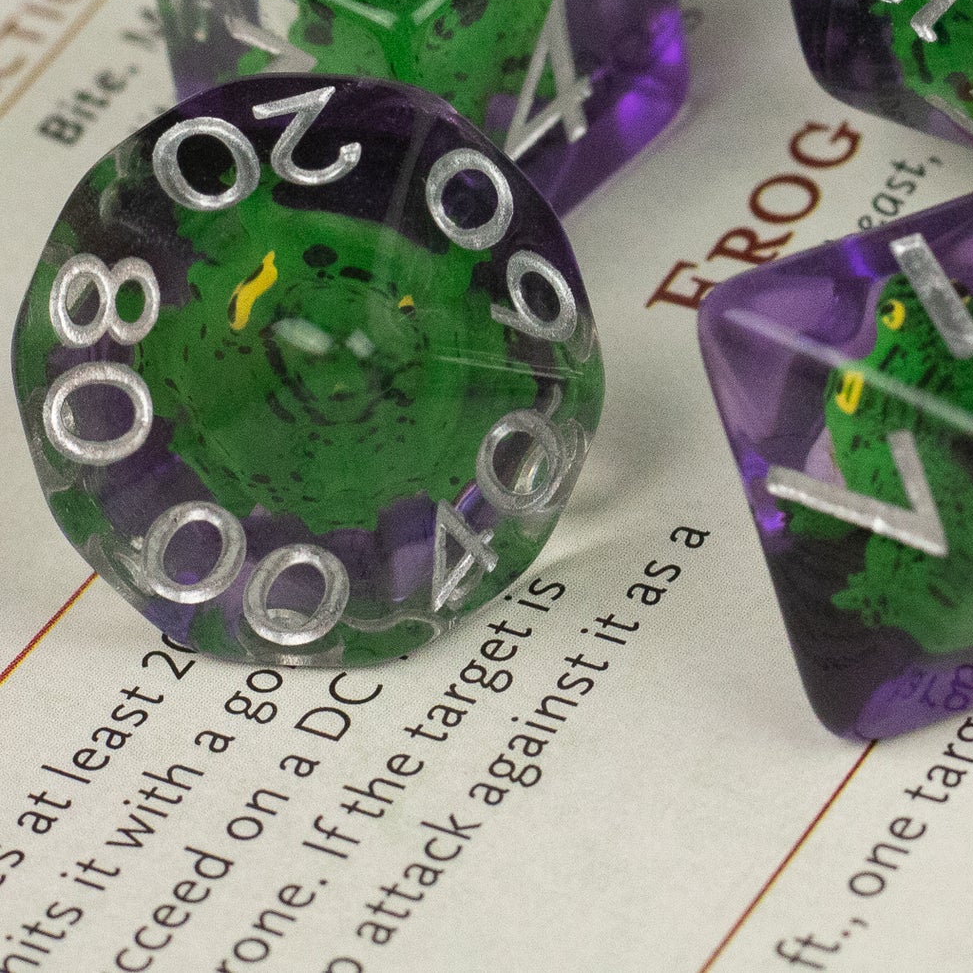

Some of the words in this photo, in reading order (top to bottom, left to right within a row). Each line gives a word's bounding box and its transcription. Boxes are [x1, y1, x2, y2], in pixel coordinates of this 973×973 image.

[36, 67, 141, 146] Bite.
[151, 85, 363, 213] 20
[645, 119, 864, 311] FROG
[41, 685, 165, 785] least
[279, 753, 321, 778] a
[293, 670, 384, 742] DC
[302, 814, 361, 860] If
[340, 752, 426, 819] the
[403, 619, 533, 744] target
[503, 576, 567, 613] is
[355, 813, 483, 946] attack
[468, 652, 611, 807] against
[580, 612, 641, 646] it
[626, 559, 683, 607] as
[669, 525, 711, 550] a
[17, 790, 73, 835] at
[59, 858, 121, 892] it
[105, 763, 205, 848] with
[194, 729, 236, 754] a
[223, 668, 285, 725] go
[226, 788, 290, 841] on
[115, 845, 235, 973] cceed
[775, 916, 870, 971] ft.,
[848, 814, 929, 898] one
